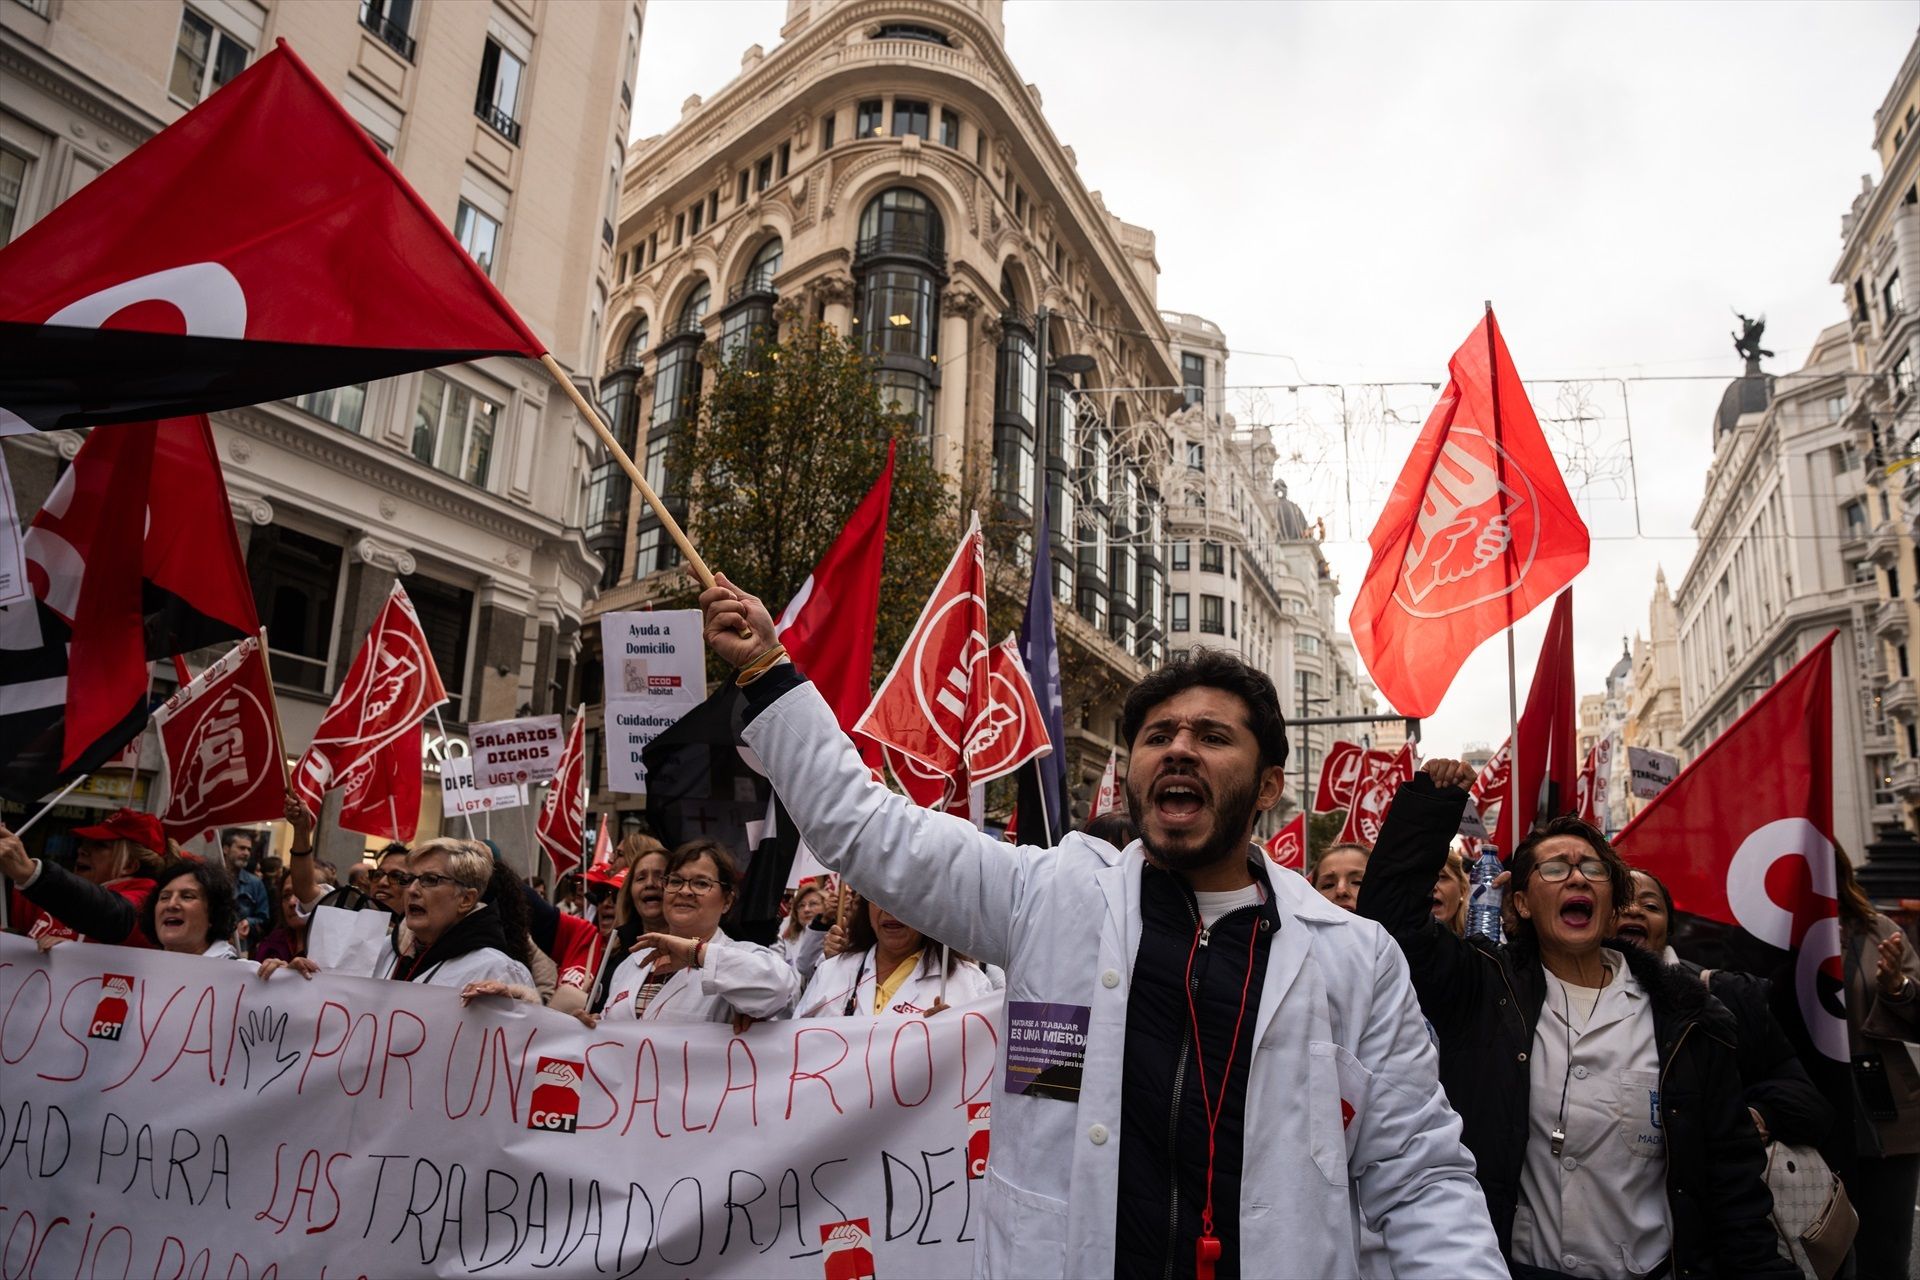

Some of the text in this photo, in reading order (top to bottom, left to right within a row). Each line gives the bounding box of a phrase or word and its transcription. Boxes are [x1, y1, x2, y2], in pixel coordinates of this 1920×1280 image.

[629, 624, 670, 638] Ayuda a
[626, 642, 675, 654] Domicilio
[475, 728, 557, 748] SALARIOS
[487, 746, 550, 764] DIGNOS
[488, 771, 514, 785] UGT
[92, 1020, 121, 1039] CGT
[1011, 1028, 1022, 1040] ES
[1023, 1029, 1040, 1041] UNA
[1040, 1021, 1079, 1031] TRABAJAR
[298, 1001, 426, 1111] POR
[444, 1021, 538, 1124] UN
[576, 1018, 933, 1138] SALARIO
[531, 1110, 576, 1131] CGT
[97, 1112, 231, 1210] PARA
[254, 1143, 352, 1235] LAS
[362, 1154, 849, 1280] TRABAJADORAS
[881, 1147, 976, 1246] DEL
